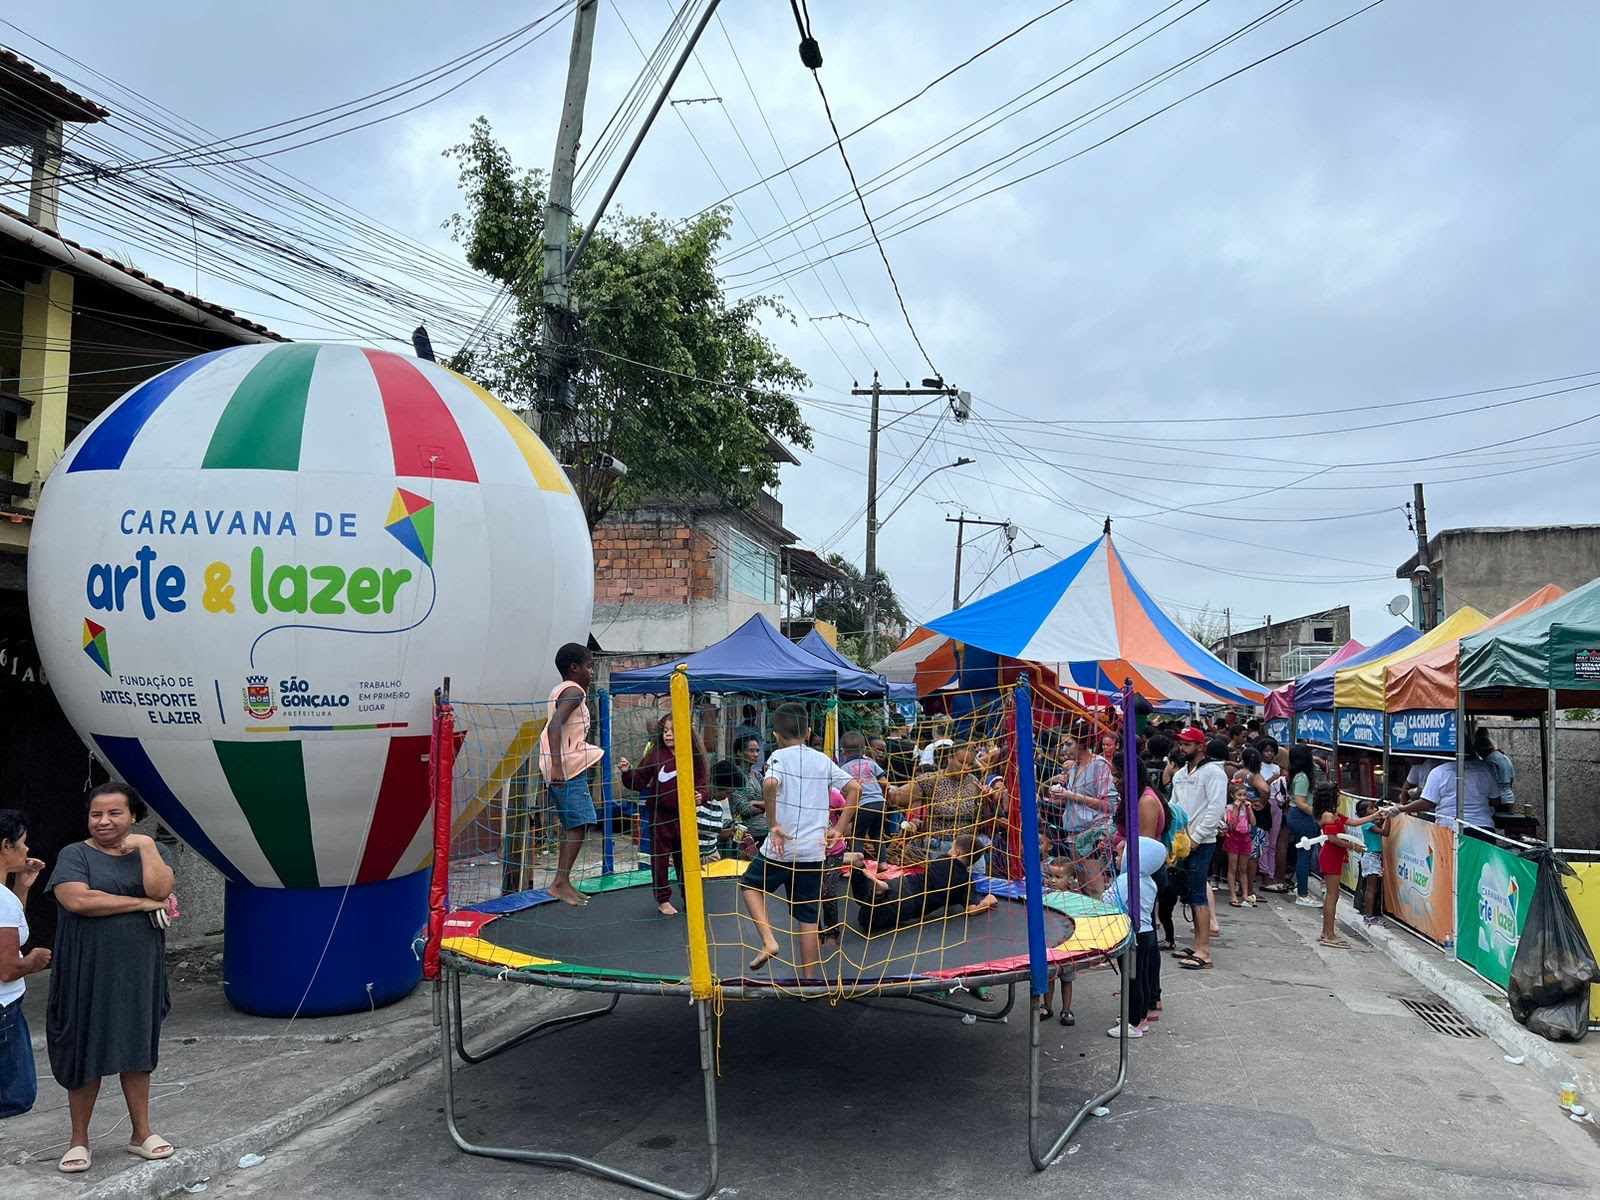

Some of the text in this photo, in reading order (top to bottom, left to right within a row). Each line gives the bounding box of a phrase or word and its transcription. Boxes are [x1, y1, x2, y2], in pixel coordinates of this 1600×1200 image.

[120, 509, 357, 537] CARAVANA DE
[86, 545, 412, 621] arte & lazer
[119, 674, 194, 690] FUNDAÇÃO DE
[279, 676, 309, 693] SÃO
[359, 680, 402, 689] TRABALHO
[100, 690, 198, 708] ARTES, ESPORTE
[281, 694, 350, 709] GONÇALO
[359, 691, 411, 701] EM PRIMEIRO
[358, 704, 386, 712] LUGAR
[148, 711, 202, 725] E LAZER
[1408, 714, 1446, 729] CACHORRO
[1353, 727, 1373, 741] QUENTE
[1412, 731, 1440, 747] QUENTE
[1412, 867, 1429, 888] lazer
[1482, 886, 1503, 904] CARAVANA
[1479, 899, 1493, 923] rte
